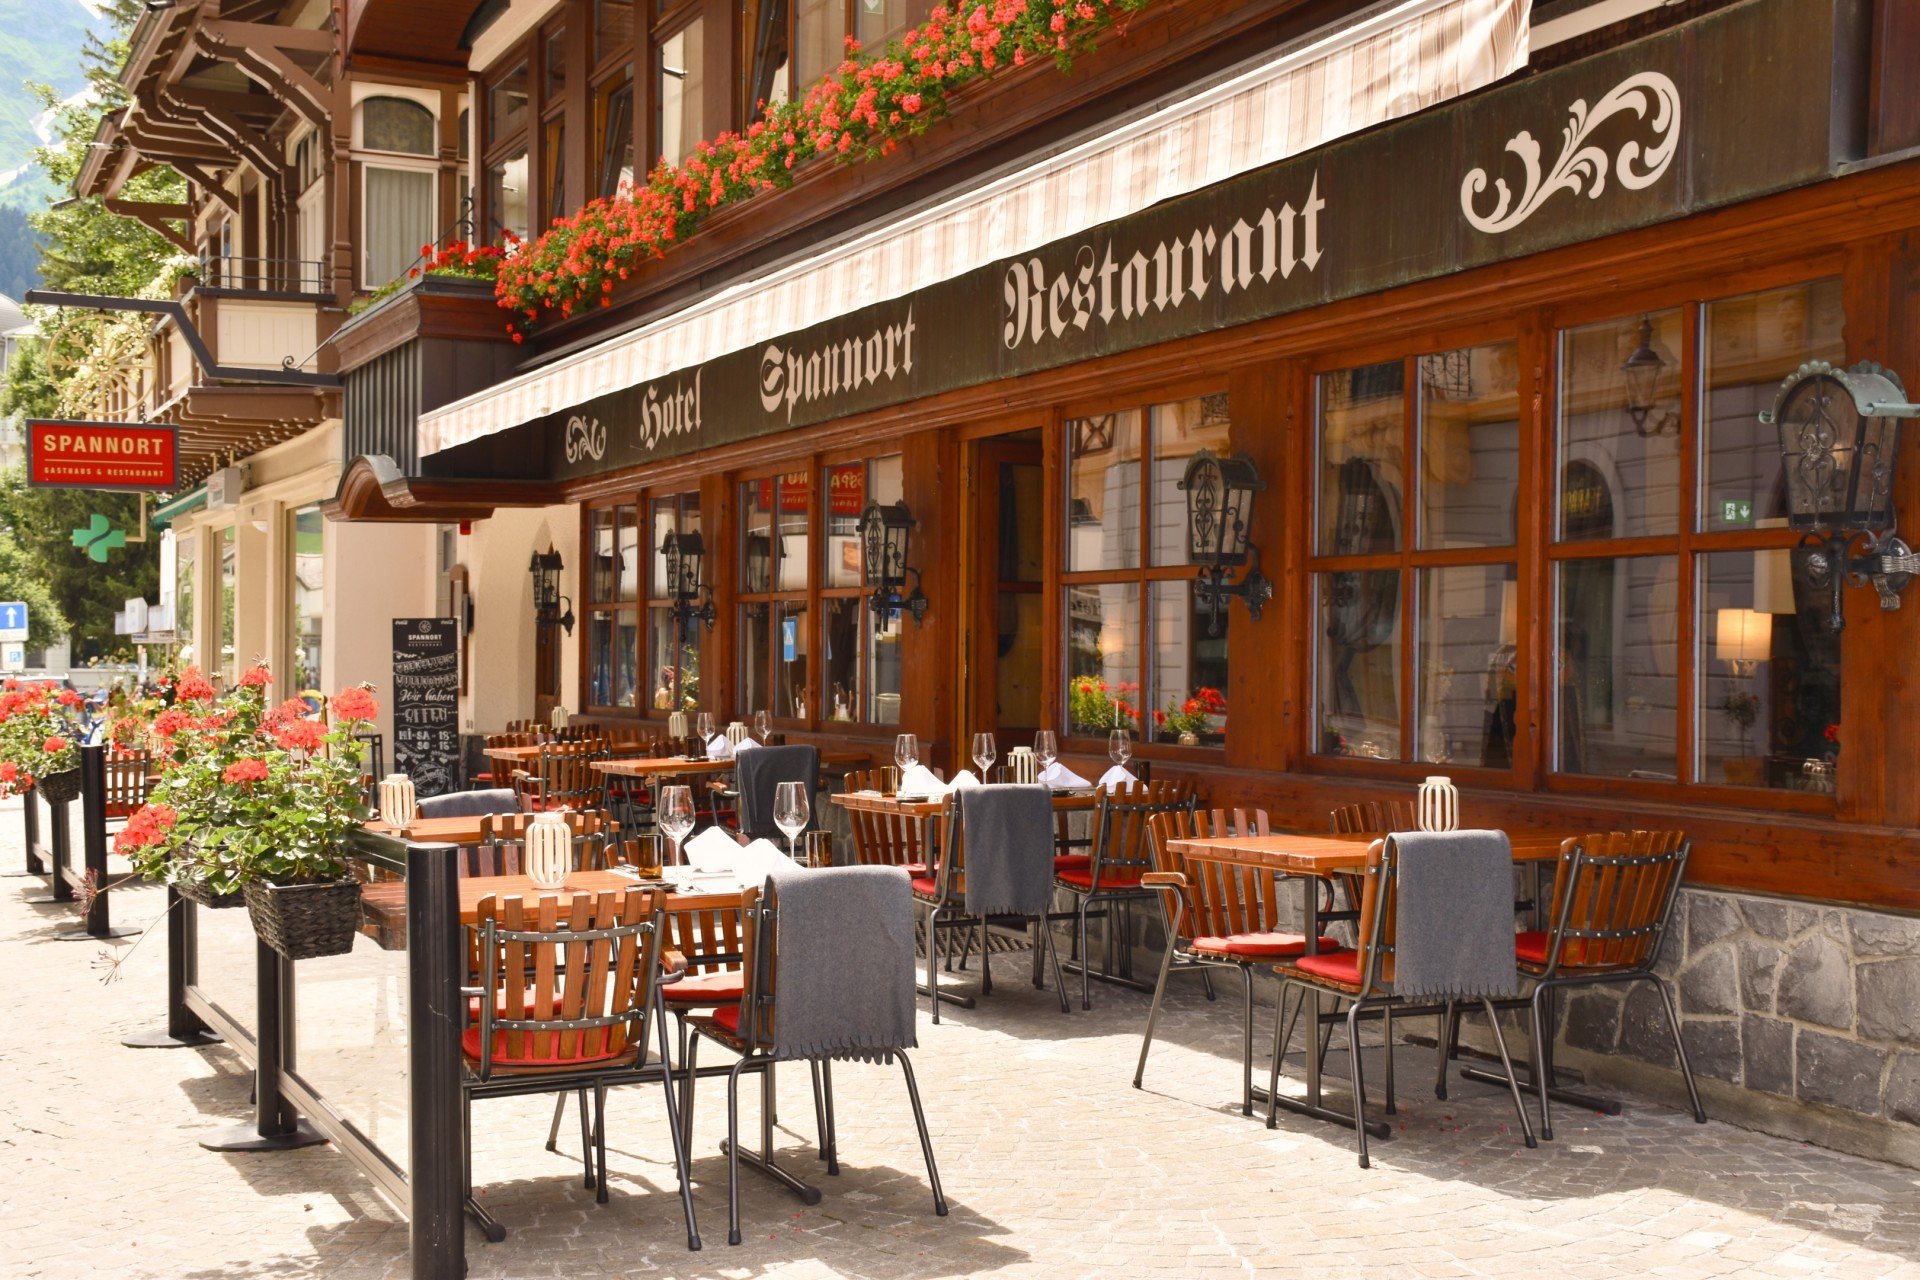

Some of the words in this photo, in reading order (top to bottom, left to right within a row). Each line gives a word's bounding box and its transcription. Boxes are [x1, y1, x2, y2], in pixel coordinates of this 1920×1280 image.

[640, 366, 703, 450] Hotel
[759, 304, 915, 424] Spannort
[1003, 169, 1325, 350] Restaurant
[44, 434, 163, 455] SPANNORT
[44, 466, 91, 476] GASTHAUS
[107, 468, 164, 477] RESTAURANT
[425, 688, 455, 701] haben
[404, 707, 447, 723] OFFEN
